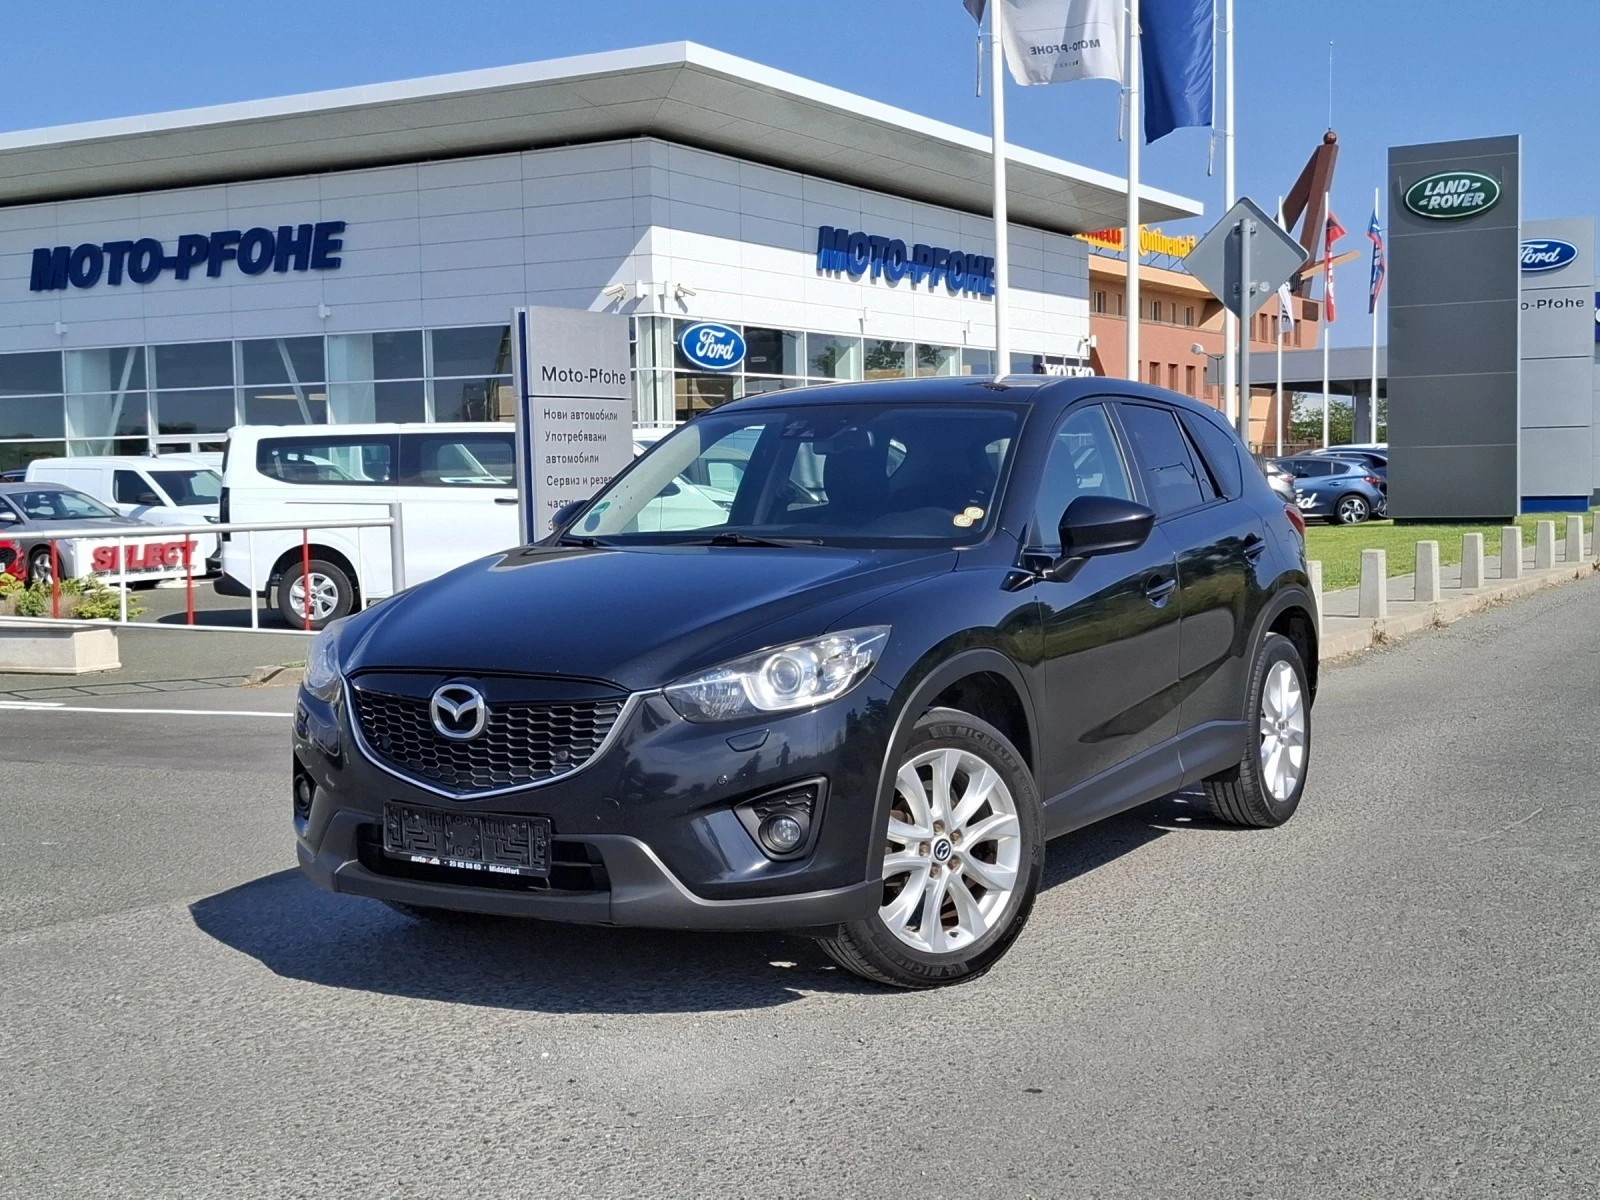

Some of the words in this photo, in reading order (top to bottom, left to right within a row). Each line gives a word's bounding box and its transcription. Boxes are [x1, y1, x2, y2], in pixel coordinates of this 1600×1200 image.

[1424, 179, 1470, 196] LAND
[1427, 191, 1486, 210] ROVER
[30, 221, 346, 291] MOTO-PFOHE
[1520, 298, 1585, 310] o-Pfohe
[695, 328, 735, 361] Ford
[541, 366, 626, 385] Moto-Pfohe
[543, 408, 568, 420] Нови
[570, 408, 618, 421] автомобили
[545, 430, 607, 444] Употребявани
[545, 452, 599, 464] автомобили
[546, 475, 580, 488] Сервиз
[582, 476, 588, 485] и
[955, 726, 1018, 769] MICHELIN
